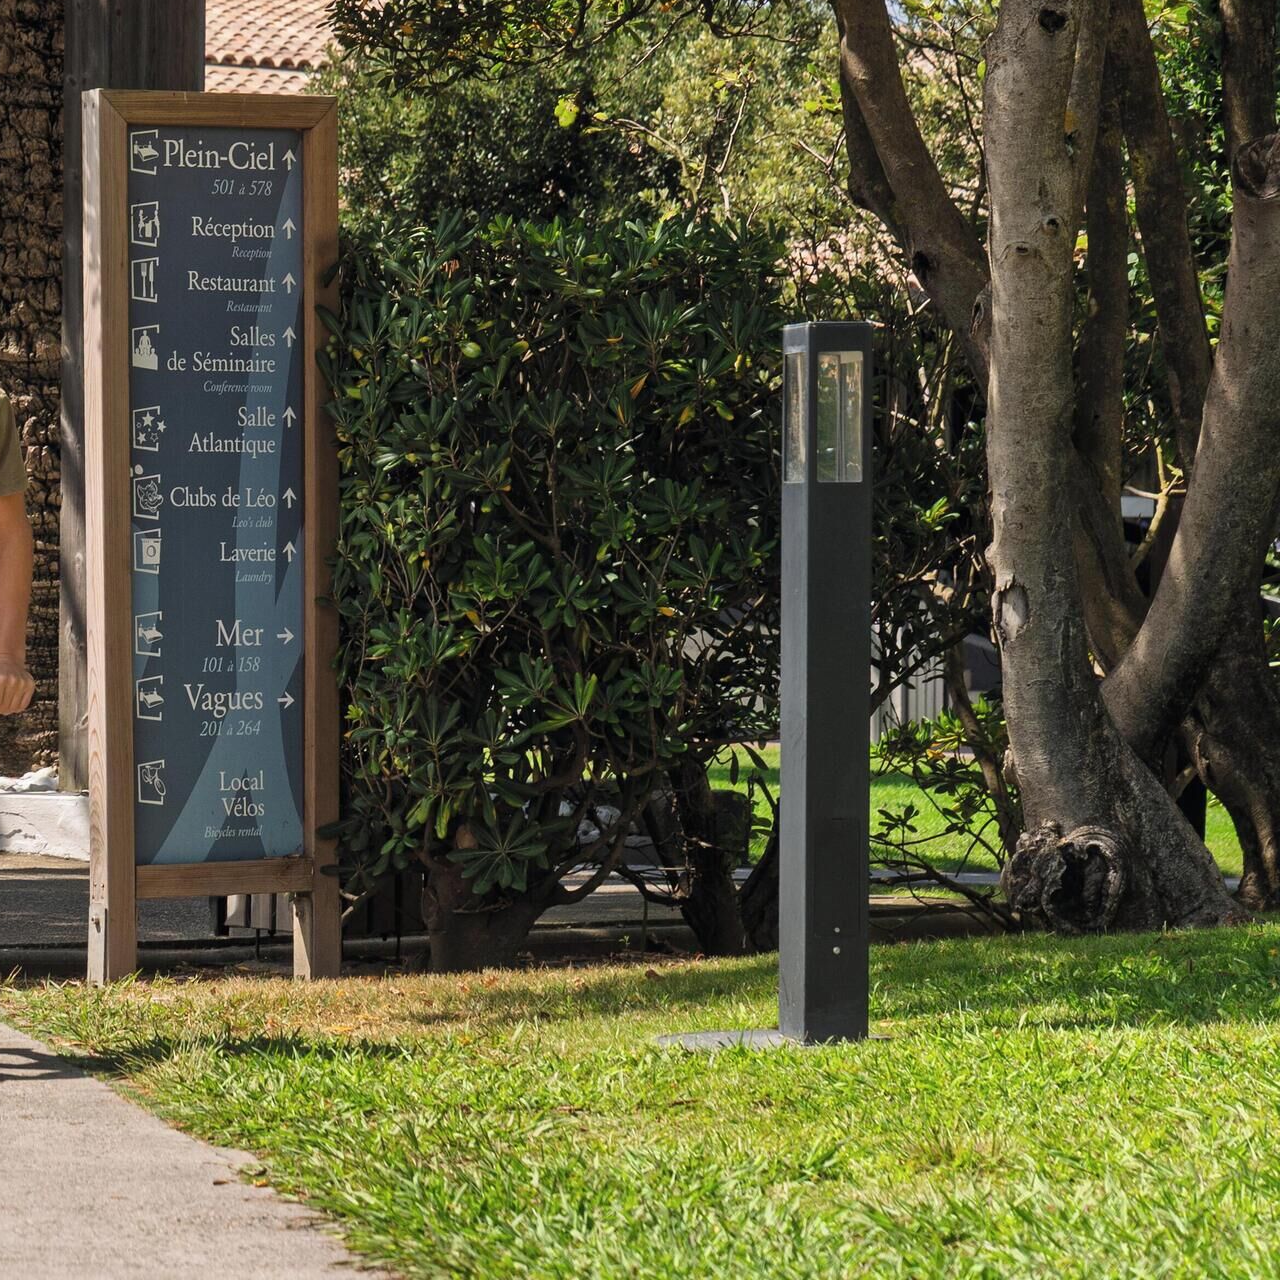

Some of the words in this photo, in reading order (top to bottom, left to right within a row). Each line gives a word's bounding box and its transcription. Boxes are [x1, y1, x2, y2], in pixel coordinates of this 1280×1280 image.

[163, 139, 275, 170] Plein-Ciel
[212, 179, 234, 194] 501
[239, 184, 245, 195] à
[249, 181, 272, 196] 578
[192, 216, 275, 242] Réception
[232, 246, 272, 261] Reception
[188, 271, 275, 292] Restaurant
[226, 300, 272, 312] Restaurant
[230, 326, 275, 346] Salles
[167, 350, 186, 371] de
[193, 352, 275, 372] Séminaire
[204, 380, 249, 395] Conference
[251, 383, 272, 393] room
[238, 406, 275, 426] Salle
[188, 432, 275, 458] Atlantique
[170, 486, 216, 506] Clubs
[222, 487, 240, 506] de
[246, 488, 275, 507] Léo
[232, 517, 253, 528] Leo's
[256, 516, 272, 527] club
[220, 542, 275, 561] Laverie
[236, 570, 273, 586] Laundry
[216, 620, 263, 646] Mer
[202, 657, 223, 672] 101
[227, 661, 233, 672] à
[238, 657, 260, 672] 158
[184, 684, 263, 718] Vagues
[200, 721, 222, 736] 201
[227, 724, 233, 735] à
[236, 720, 261, 735] 264
[220, 770, 264, 791] Local
[222, 797, 264, 816] Vélos
[204, 826, 236, 840] Bicycles
[238, 825, 263, 838] rental
